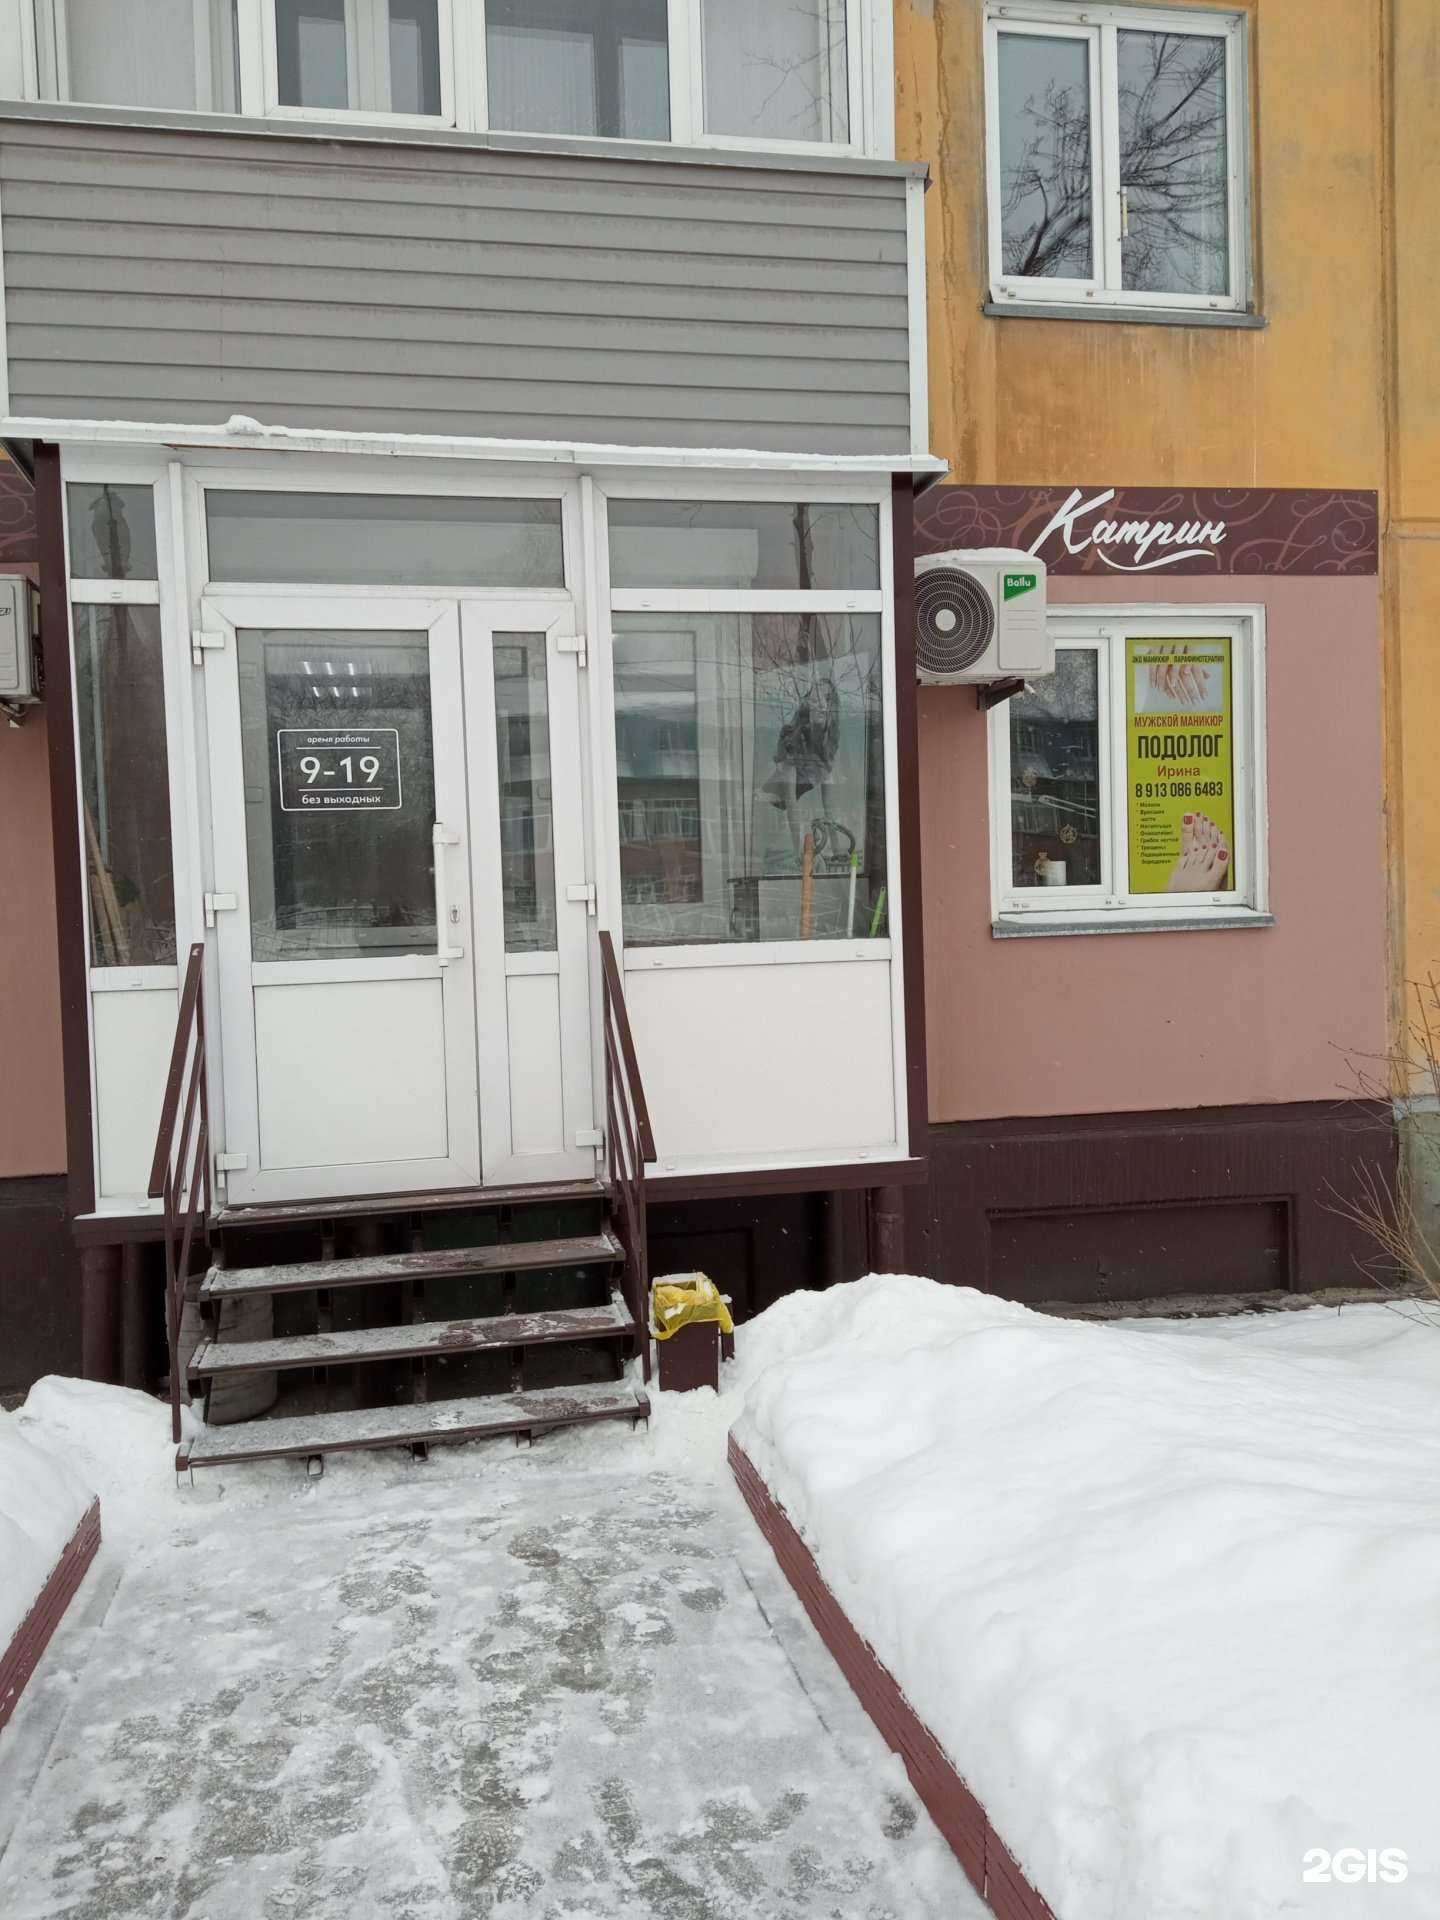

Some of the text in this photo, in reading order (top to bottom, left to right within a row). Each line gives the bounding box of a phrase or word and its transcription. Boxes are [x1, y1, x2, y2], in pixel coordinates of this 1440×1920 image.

[1028, 488, 1227, 564] Катрин
[1007, 576, 1031, 587] Ballu
[1134, 715, 1224, 727] МУЖСКОЙ МАНИКЮР
[335, 735, 370, 745] работы
[1138, 734, 1224, 760] ПОДОЛОГ
[299, 756, 380, 784] 9-19
[1158, 765, 1201, 779] Ирина
[1135, 781, 1224, 798] 8 913 086 6483
[302, 795, 381, 805] без выходных
